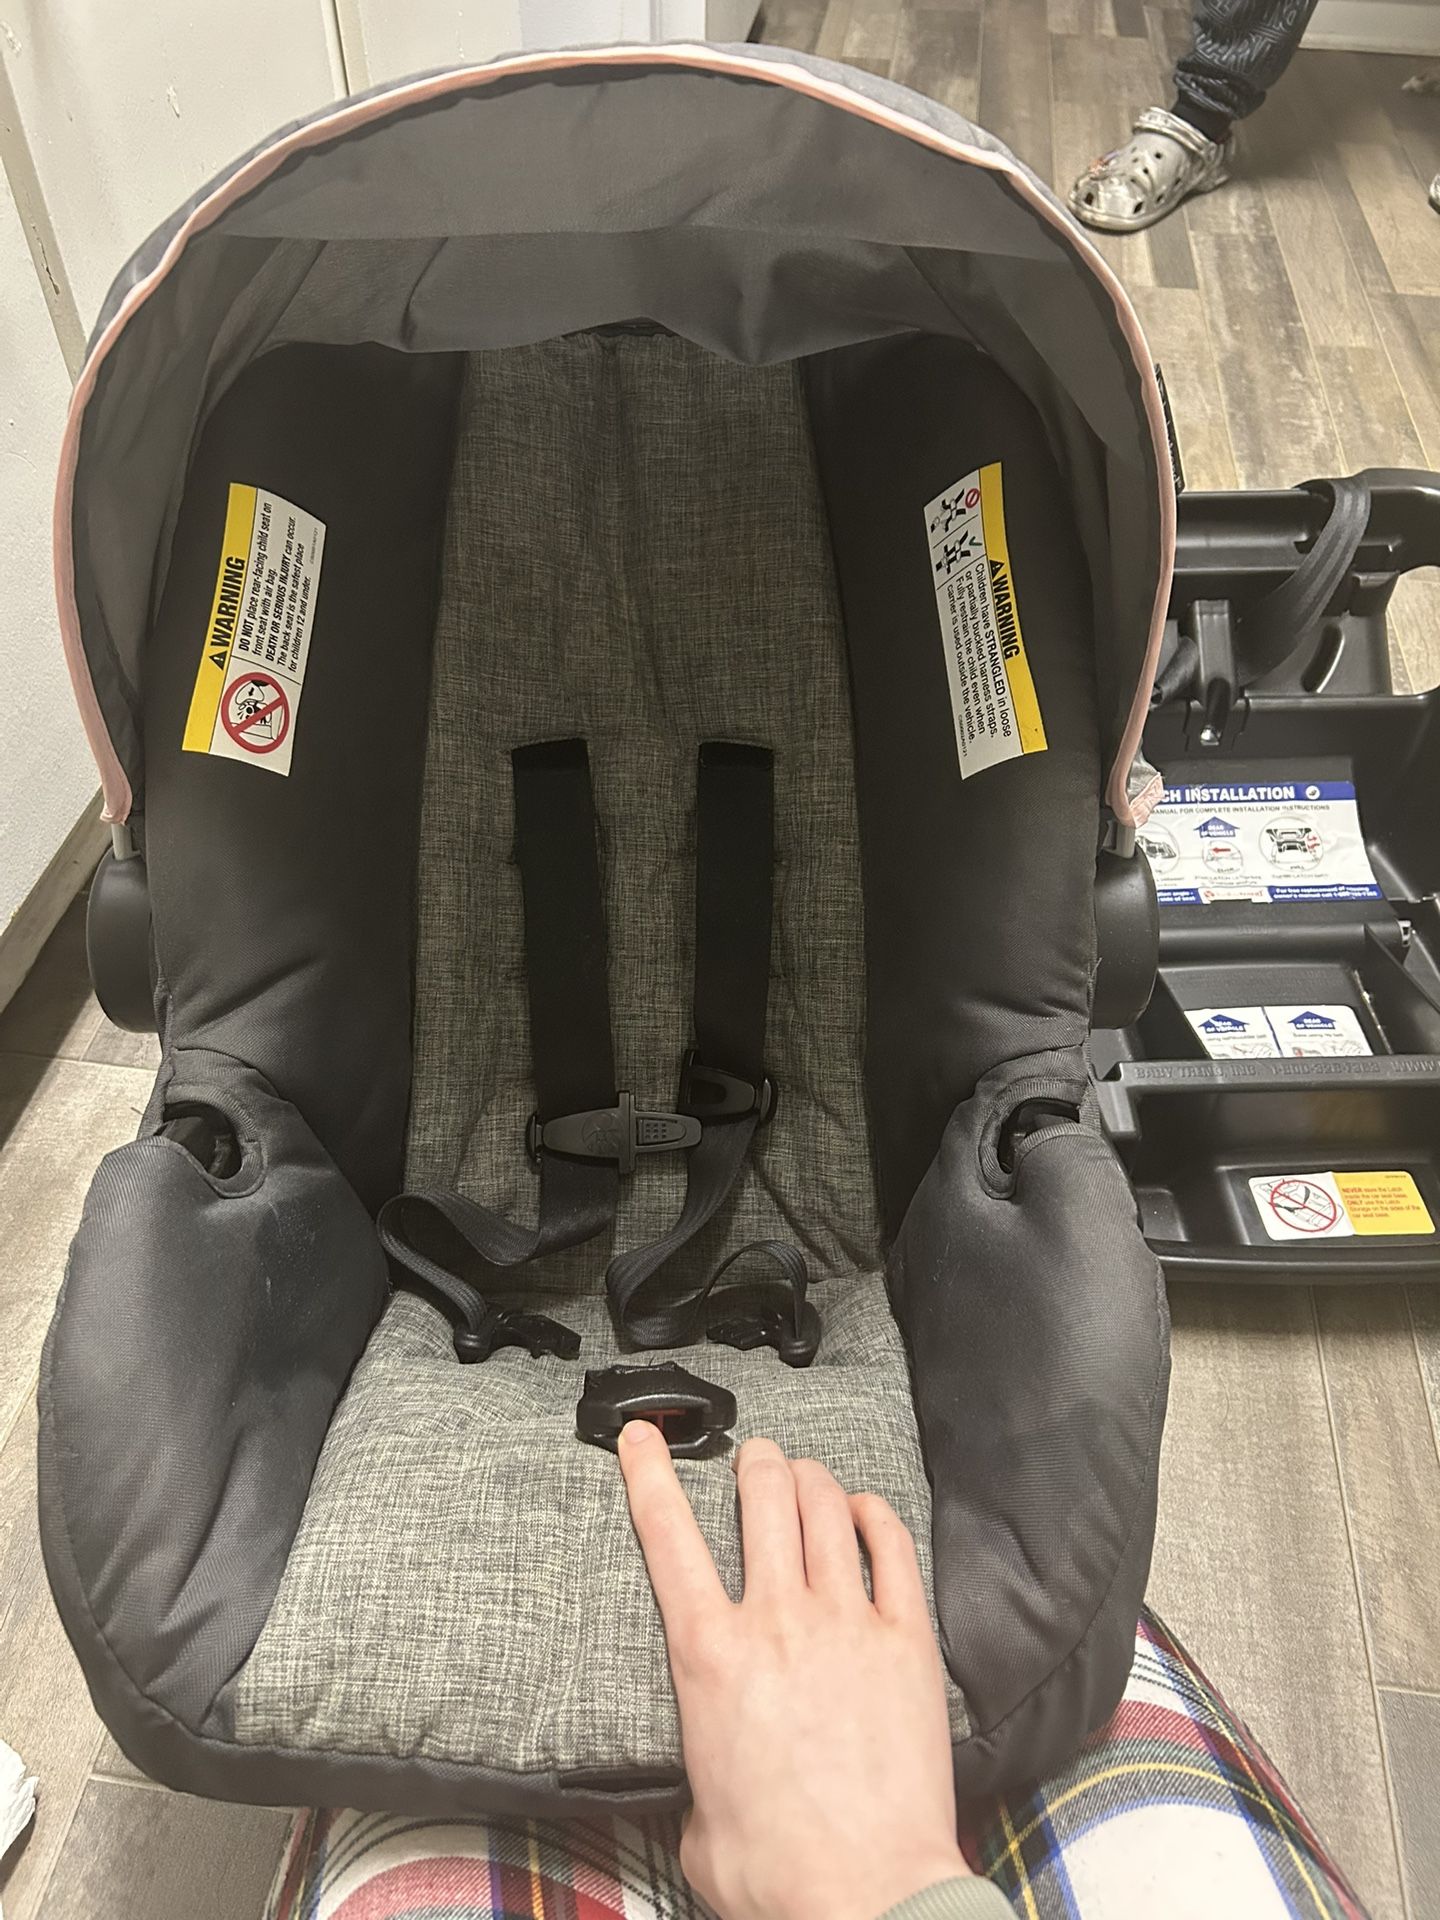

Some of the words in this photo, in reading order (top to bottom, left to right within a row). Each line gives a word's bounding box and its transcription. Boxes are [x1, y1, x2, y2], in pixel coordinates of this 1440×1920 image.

[263, 502, 272, 514] on
[260, 512, 271, 532] seat
[286, 516, 297, 540] occur.
[256, 530, 269, 552] child
[285, 539, 294, 556] can
[294, 543, 305, 567] place
[251, 552, 268, 596] rear-facing
[264, 568, 278, 586] bag.
[279, 553, 291, 586] INJURY
[290, 563, 302, 590] safest
[965, 570, 972, 581] or
[264, 585, 273, 598] air
[301, 576, 312, 601] under.
[956, 576, 965, 601] Fully
[975, 563, 987, 605] Children
[210, 556, 246, 647] WARNING
[246, 596, 258, 621] place
[261, 597, 271, 616] with
[273, 584, 287, 621] SERIOUS
[286, 603, 296, 612] is
[288, 589, 298, 604] the
[299, 598, 308, 616] and
[947, 584, 957, 615] carrier
[966, 583, 979, 621] partially
[241, 619, 254, 638] NOT
[258, 616, 268, 636] seat
[270, 620, 281, 634] OR
[285, 611, 295, 631] seat
[296, 615, 305, 627] 12
[952, 615, 959, 626] is
[959, 601, 970, 639] restrain
[980, 603, 991, 630] have
[992, 573, 1020, 660] WARNING
[238, 638, 250, 652] DO
[252, 635, 265, 656] front
[265, 633, 279, 662] DEATH
[280, 630, 291, 651] back
[291, 626, 303, 660] children
[953, 625, 963, 650] used
[964, 638, 973, 655] the
[972, 620, 986, 662] buckled
[276, 651, 288, 666] The
[288, 660, 298, 673] for
[957, 651, 968, 688] outside
[967, 656, 978, 681] child
[985, 630, 1005, 696] STRANGLED
[971, 681, 981, 706] even
[979, 661, 992, 702] harness
[962, 687, 970, 705] the
[997, 696, 1008, 708] in
[965, 704, 976, 744] vehicle.
[975, 706, 986, 735] when
[986, 703, 998, 738] straps.
[999, 707, 1012, 738] loose
[1185, 786, 1296, 803] INSTALLATION
[1195, 806, 1231, 814] COMPLETE
[1232, 805, 1280, 813] INSTALLATION
[1281, 804, 1330, 812] INSTRUCTIONS
[1134, 1067, 1173, 1079] BABY
[1177, 1065, 1228, 1078] TREND,
